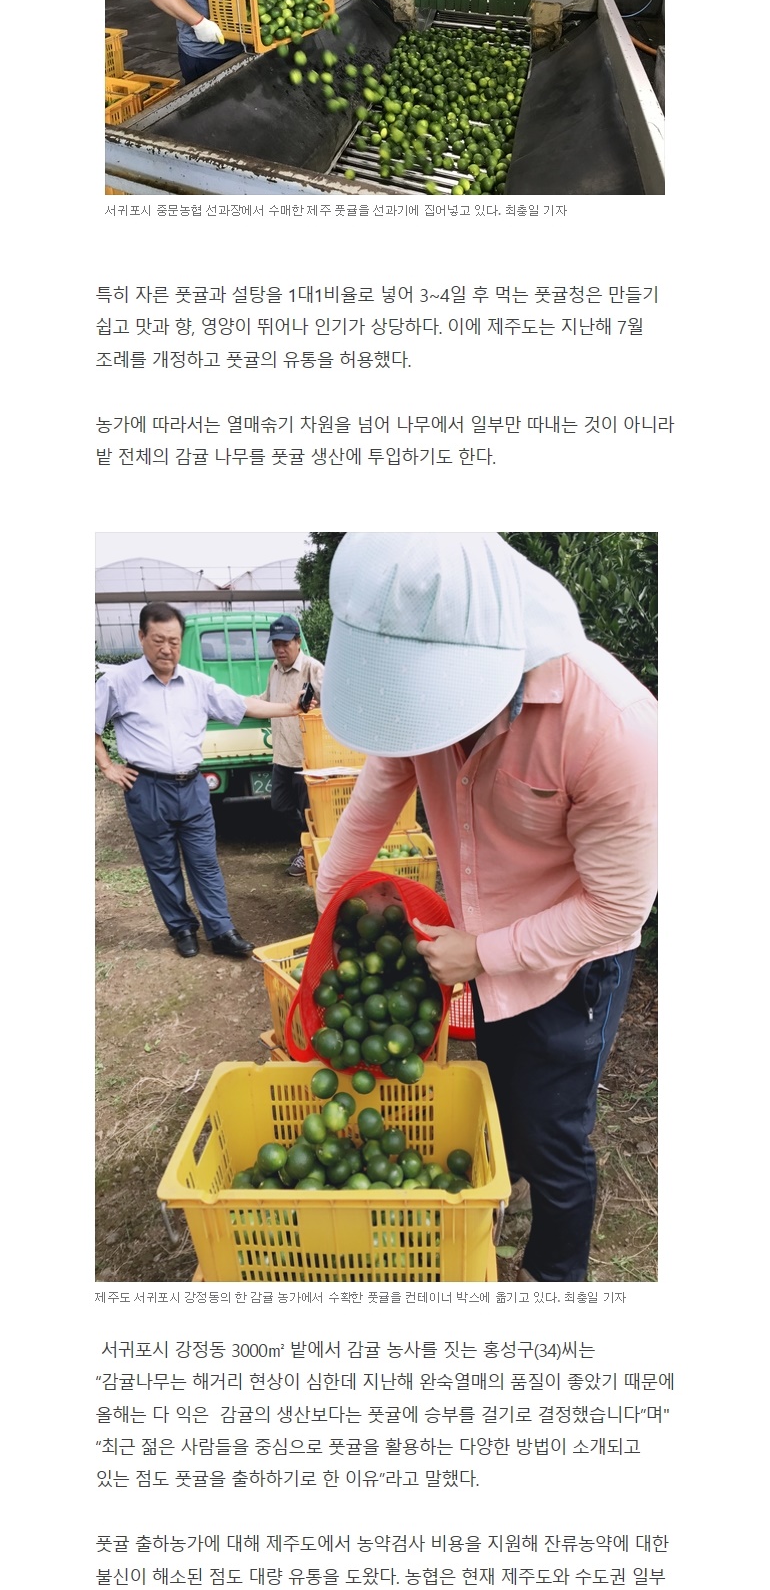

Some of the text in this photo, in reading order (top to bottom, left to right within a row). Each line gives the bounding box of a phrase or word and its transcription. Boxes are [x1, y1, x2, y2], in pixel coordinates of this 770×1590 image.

[95, 350, 412, 369] 조례를 개정하고 풋귤의 유통을 허용했다.
[101, 1340, 168, 1359] 서귀포시
[175, 1340, 227, 1359] 강정동
[290, 1340, 340, 1359] 밭에서
[347, 1340, 381, 1359] 감귤
[386, 1340, 438, 1359] 농사를
[444, 1340, 478, 1359] 짓는
[482, 1340, 596, 1361] 홍성구(34)씨는
